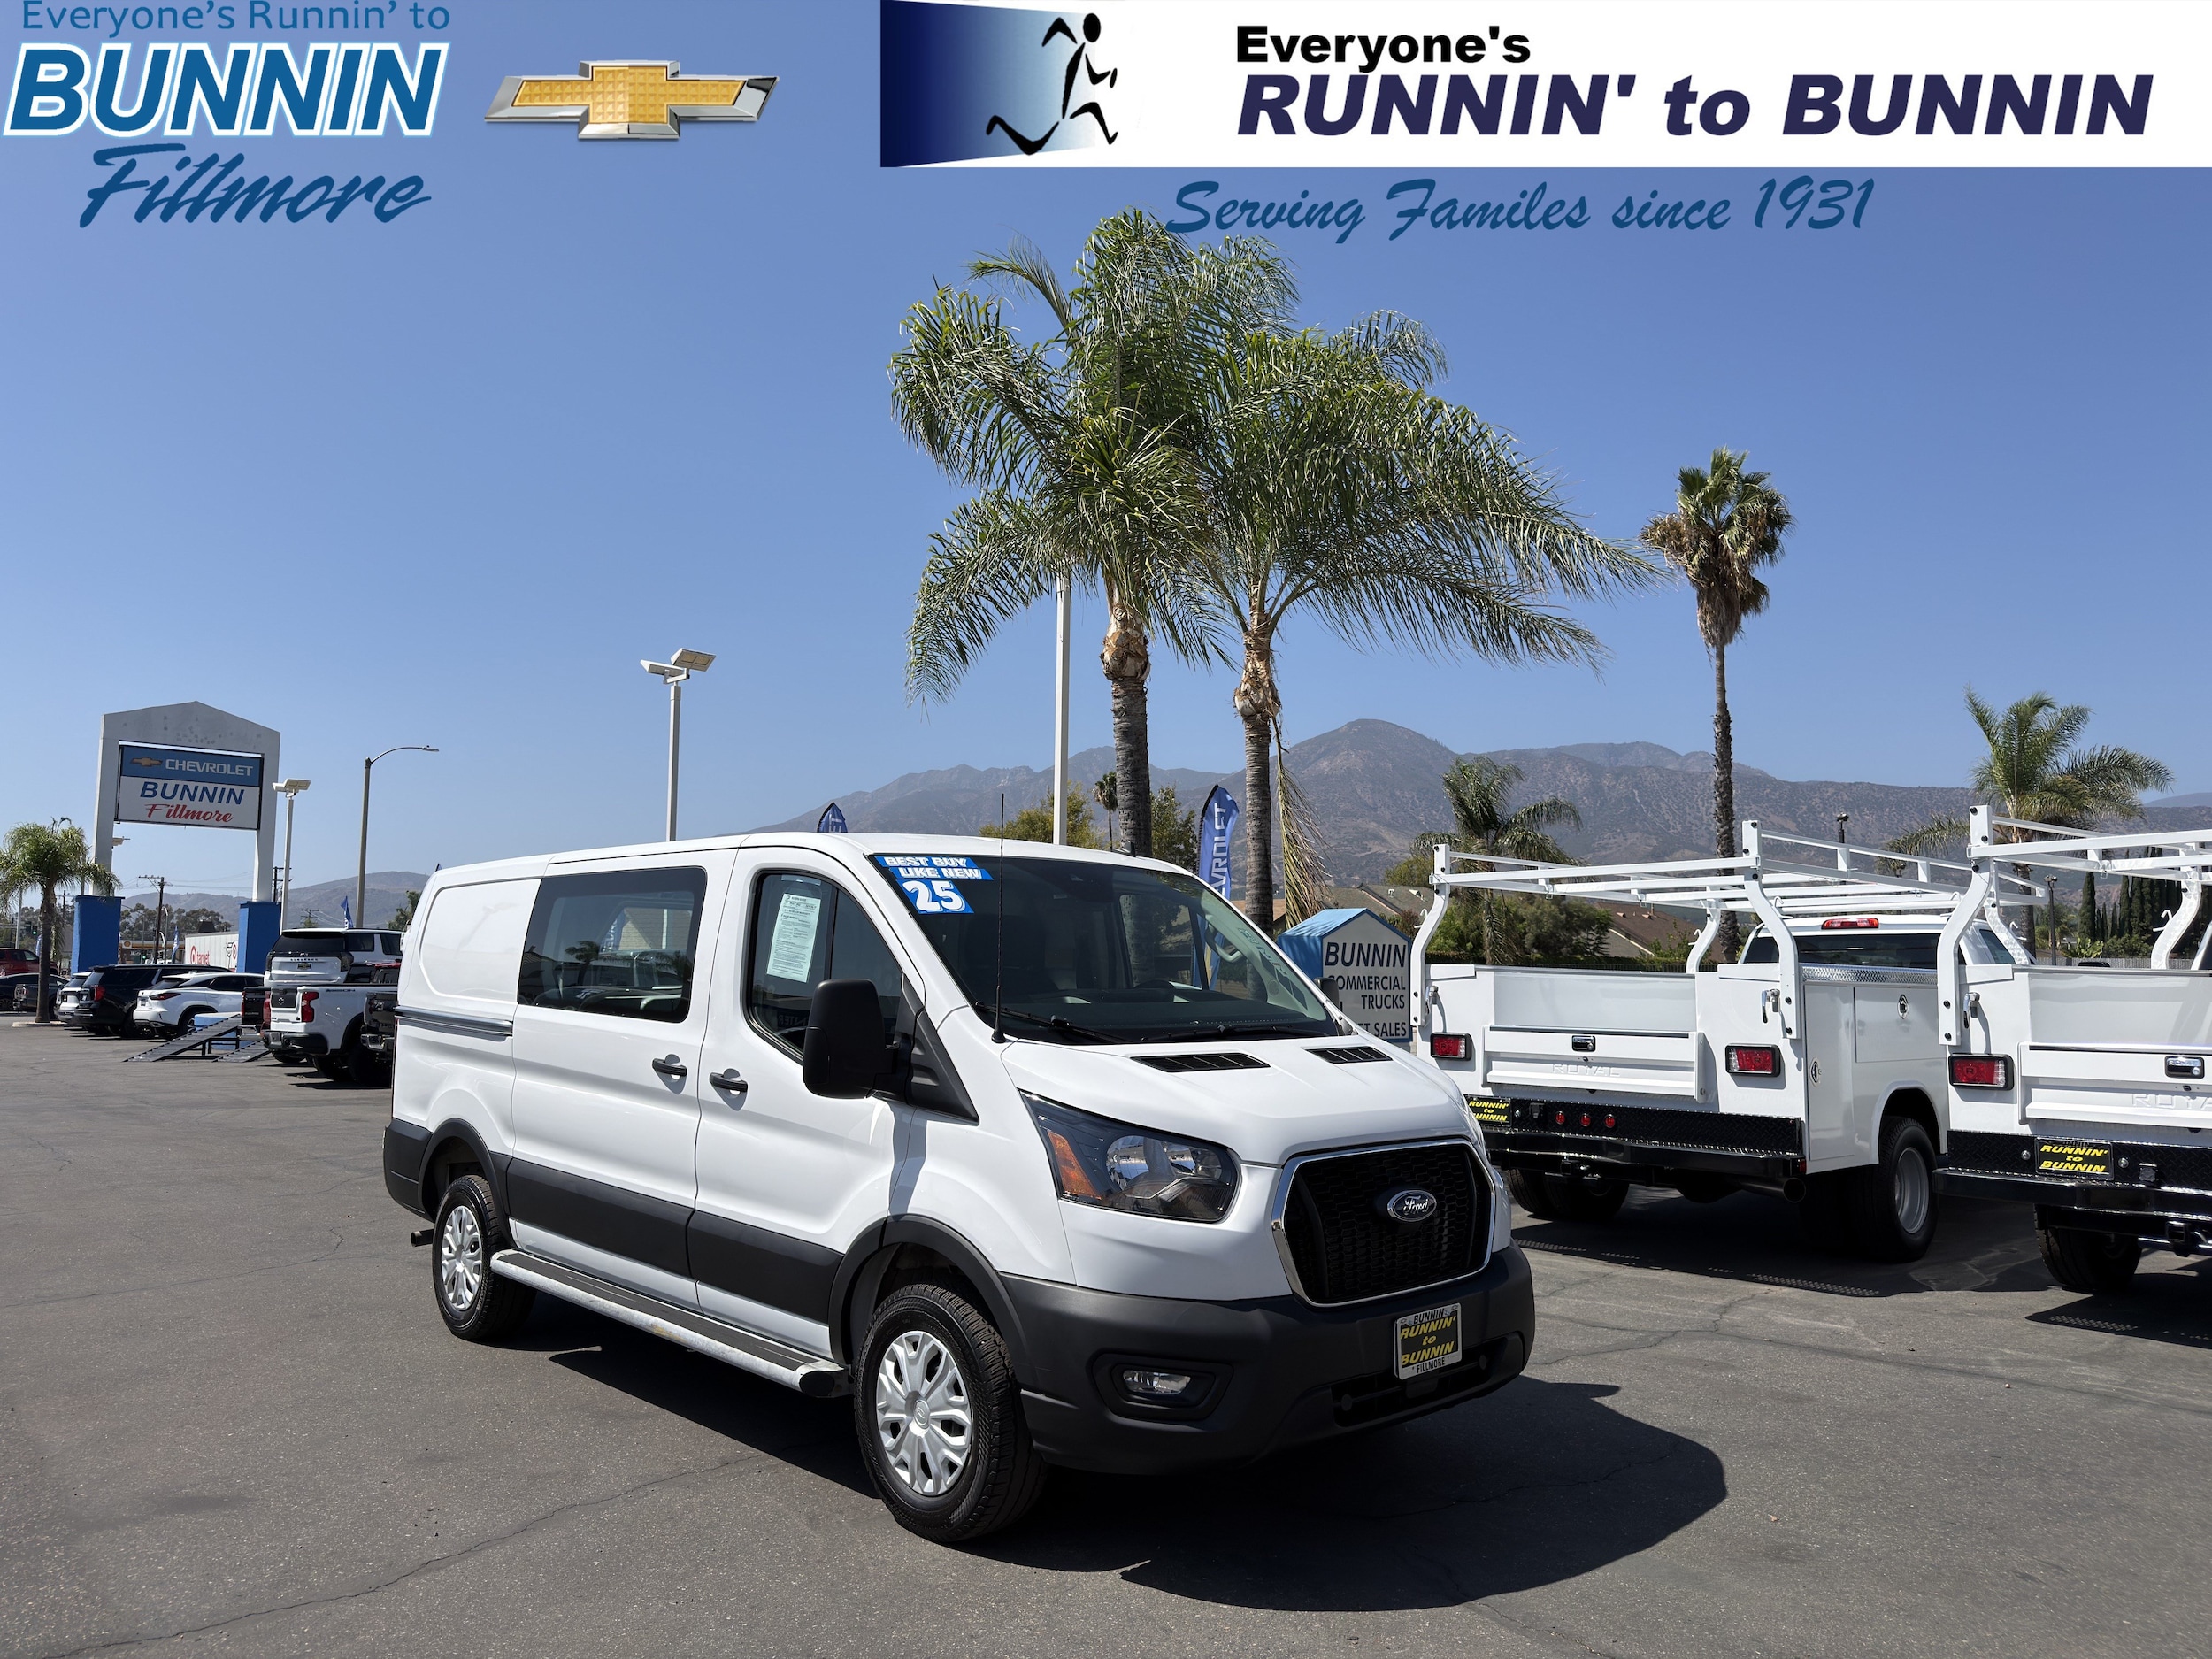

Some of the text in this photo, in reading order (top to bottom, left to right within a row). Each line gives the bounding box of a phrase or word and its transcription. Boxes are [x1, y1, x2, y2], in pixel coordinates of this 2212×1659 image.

[165, 758, 254, 776] CHEVROLET
[140, 781, 245, 805] BUNNIN
[144, 803, 234, 823] Fillmore
[883, 856, 967, 867] BEST BUY
[898, 867, 983, 879] LIKE NEW
[902, 880, 966, 912] 25
[1325, 941, 1407, 968] BUNNIN
[1328, 975, 1407, 991] OMMERCIAL
[1361, 994, 1405, 1010] TRUCKS
[1374, 1022, 1408, 1037] SALES
[1552, 1064, 1621, 1078] ROYAL
[1469, 1100, 1509, 1110] RUNNIN'
[1472, 1112, 1508, 1122] UNNIN
[2040, 1145, 2108, 1156] RUNNIN'
[2040, 1161, 2106, 1172] BUNNIN
[1413, 1308, 1444, 1325] BUNNIN
[1400, 1315, 1456, 1340] RUNNIN'
[1422, 1335, 1436, 1346] to
[1401, 1340, 1455, 1366] BUNNIN
[1417, 1356, 1445, 1374] FILLMORE
